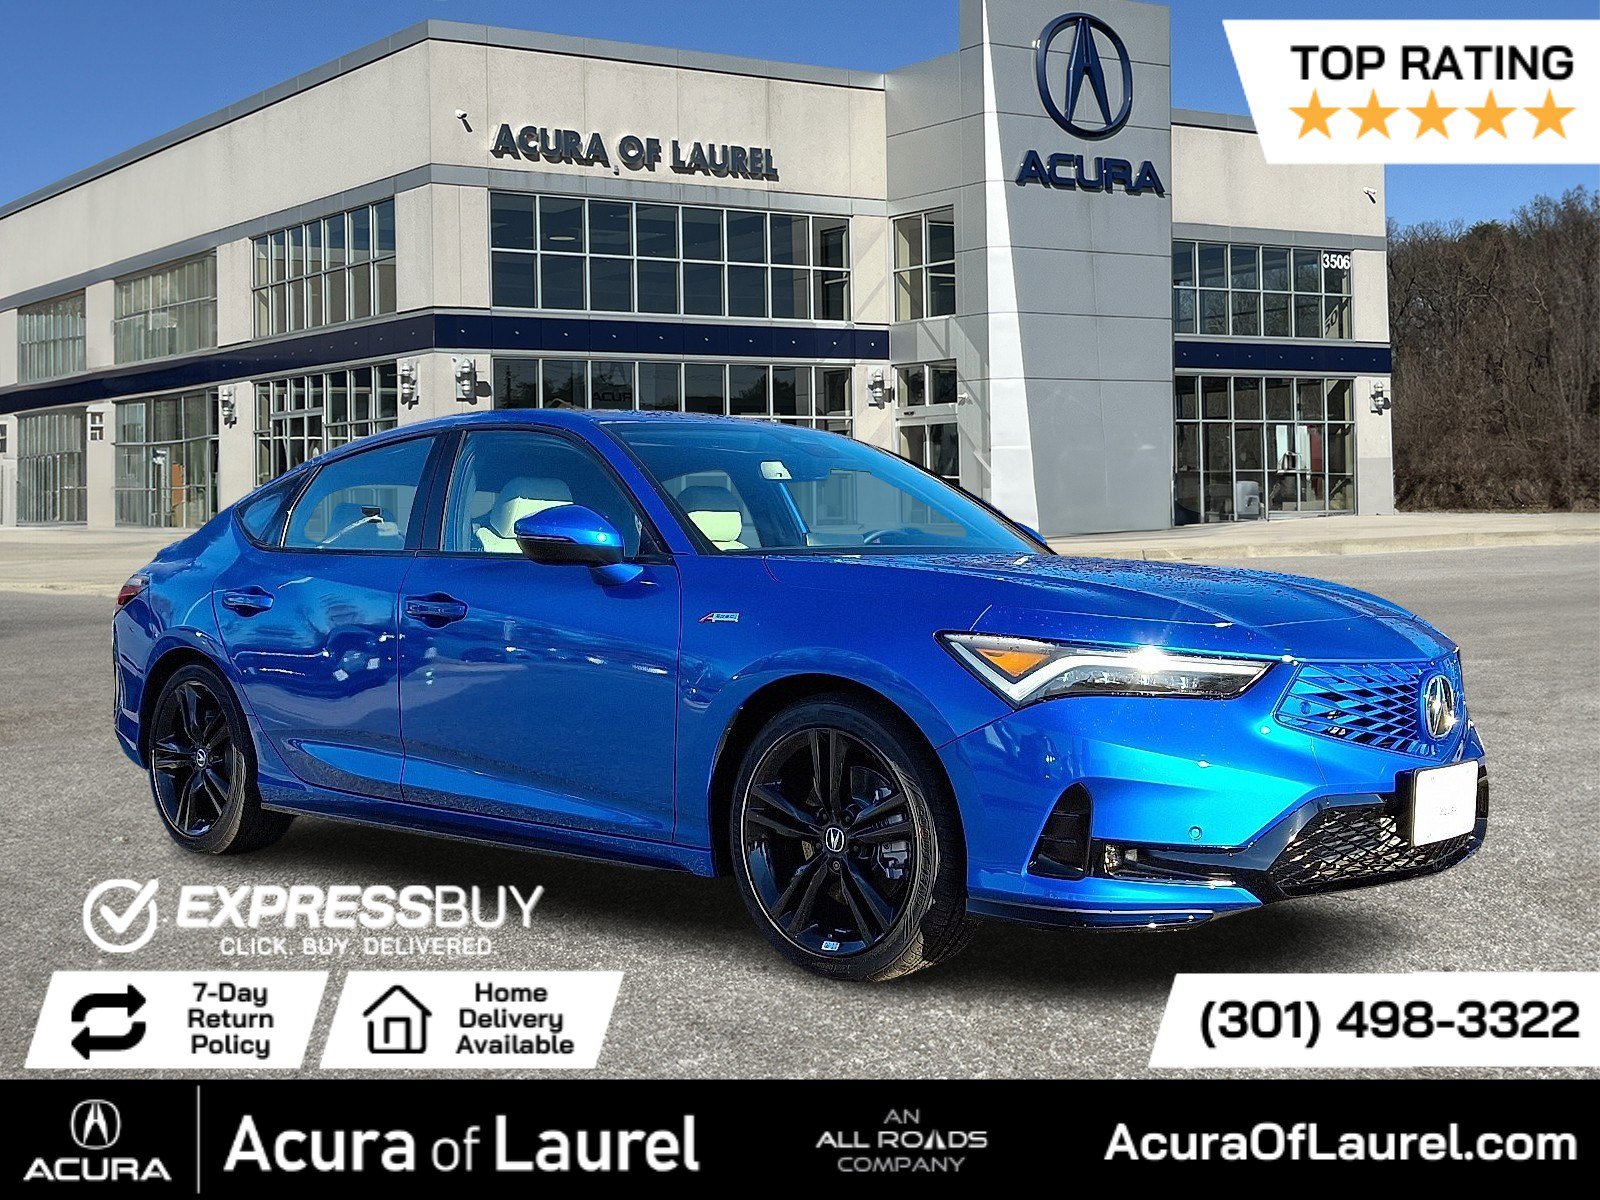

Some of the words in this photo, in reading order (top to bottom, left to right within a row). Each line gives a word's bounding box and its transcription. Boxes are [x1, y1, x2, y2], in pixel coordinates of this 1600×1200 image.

[490, 122, 611, 168] ACURA
[618, 134, 662, 172] OF
[670, 139, 779, 182] LAUREL
[1015, 149, 1166, 198] ACURA
[1322, 253, 1351, 270] 3506
